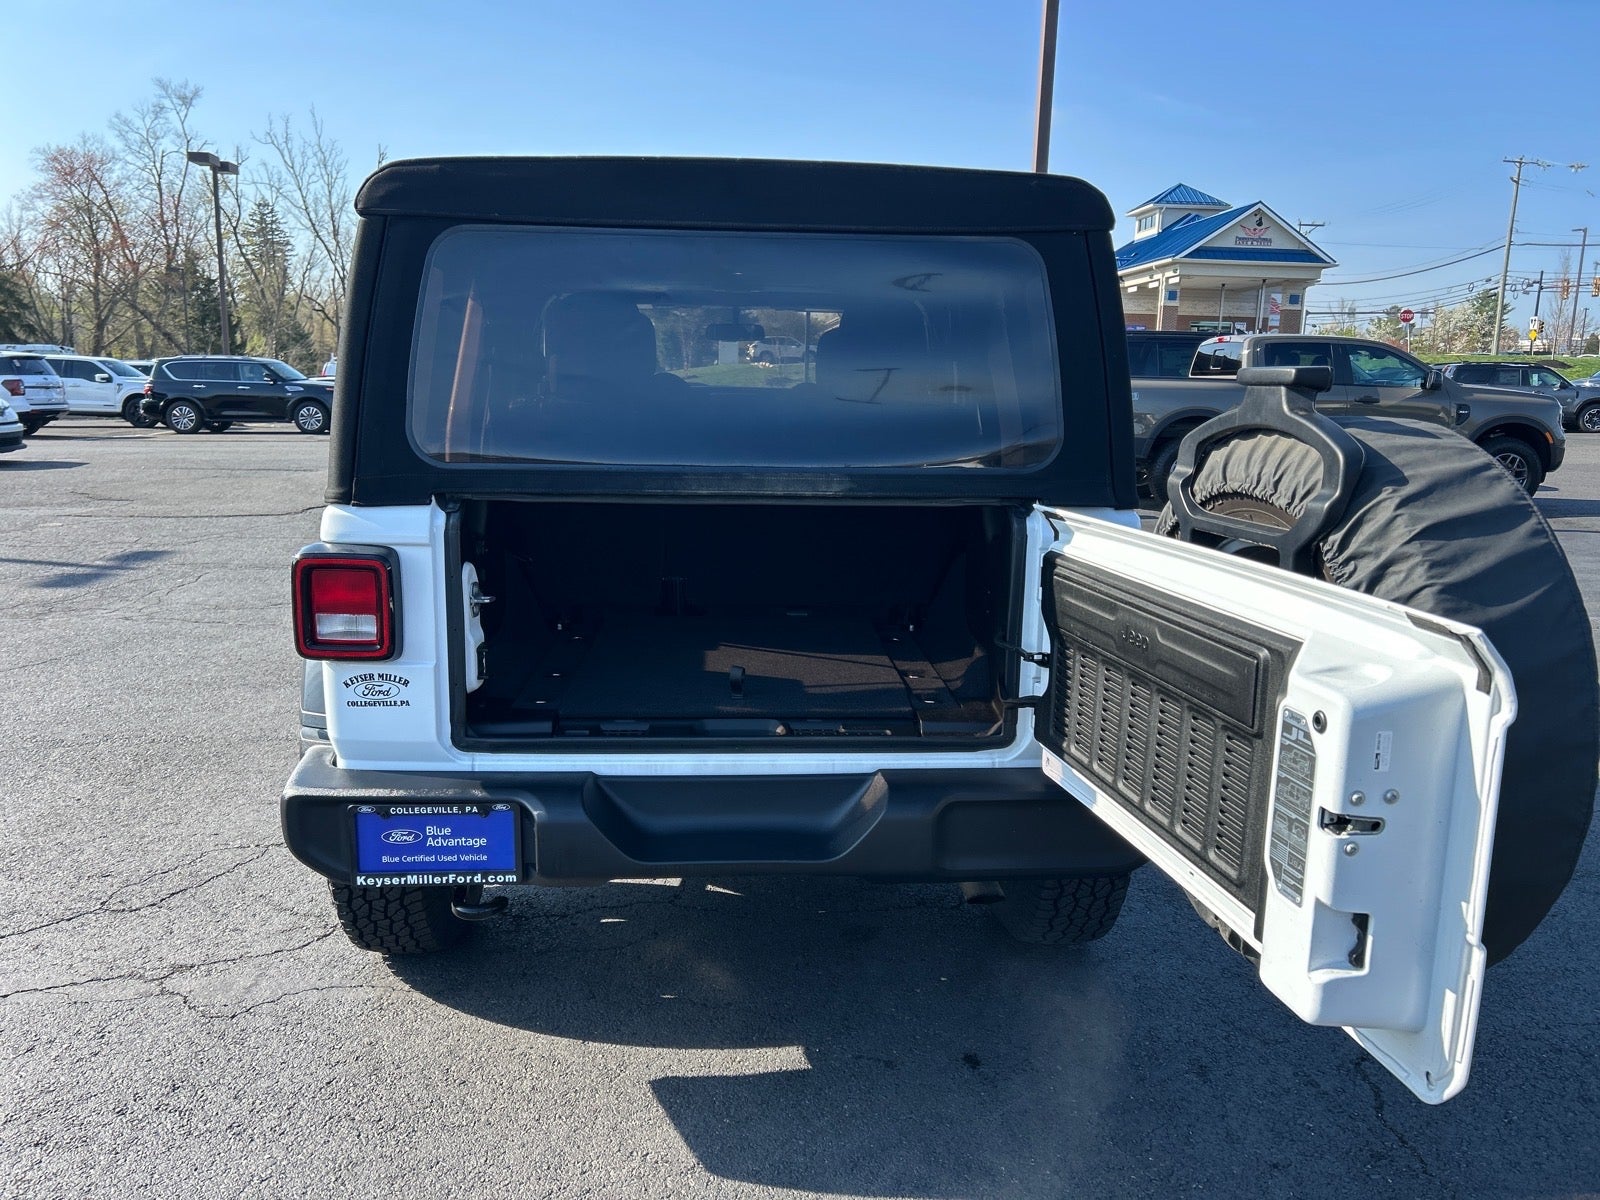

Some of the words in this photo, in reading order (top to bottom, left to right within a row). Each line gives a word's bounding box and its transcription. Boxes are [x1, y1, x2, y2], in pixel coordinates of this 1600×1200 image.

[1121, 623, 1149, 650] Jeep
[342, 672, 375, 689] KEYSER
[377, 672, 410, 688] MILLER
[362, 683, 392, 697] Ford
[1282, 726, 1312, 746] JL
[390, 806, 462, 815] COLLEGEVILLE,
[465, 806, 479, 814] PA
[389, 831, 415, 842] Ford
[426, 826, 451, 836] Blue
[426, 836, 487, 848] Advantage
[382, 855, 400, 863] Blue
[401, 854, 436, 863] Certified
[437, 854, 458, 862] Used
[459, 853, 488, 862] Vehicle
[356, 873, 517, 888] KeyserMillerFord.com
